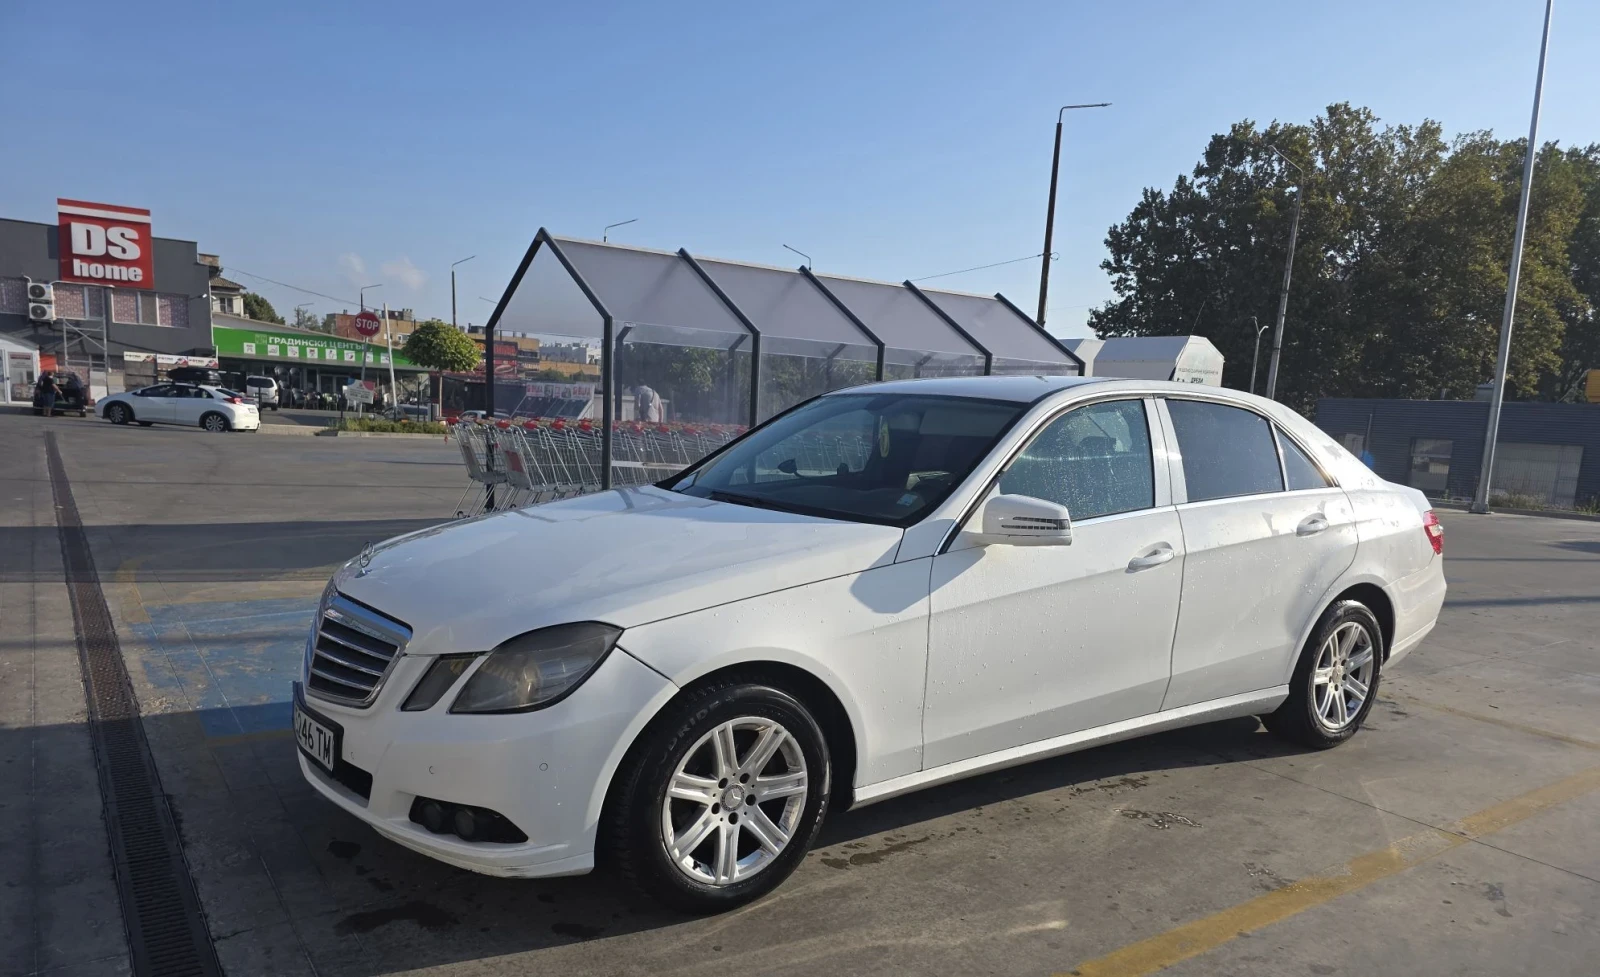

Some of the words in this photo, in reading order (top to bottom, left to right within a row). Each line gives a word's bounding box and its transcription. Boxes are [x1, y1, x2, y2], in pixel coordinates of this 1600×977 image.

[71, 222, 141, 260] DS
[73, 258, 143, 282] home
[356, 318, 379, 331] STOP
[269, 336, 327, 348] ГРАДИНСКИ
[316, 726, 331, 765] TM
